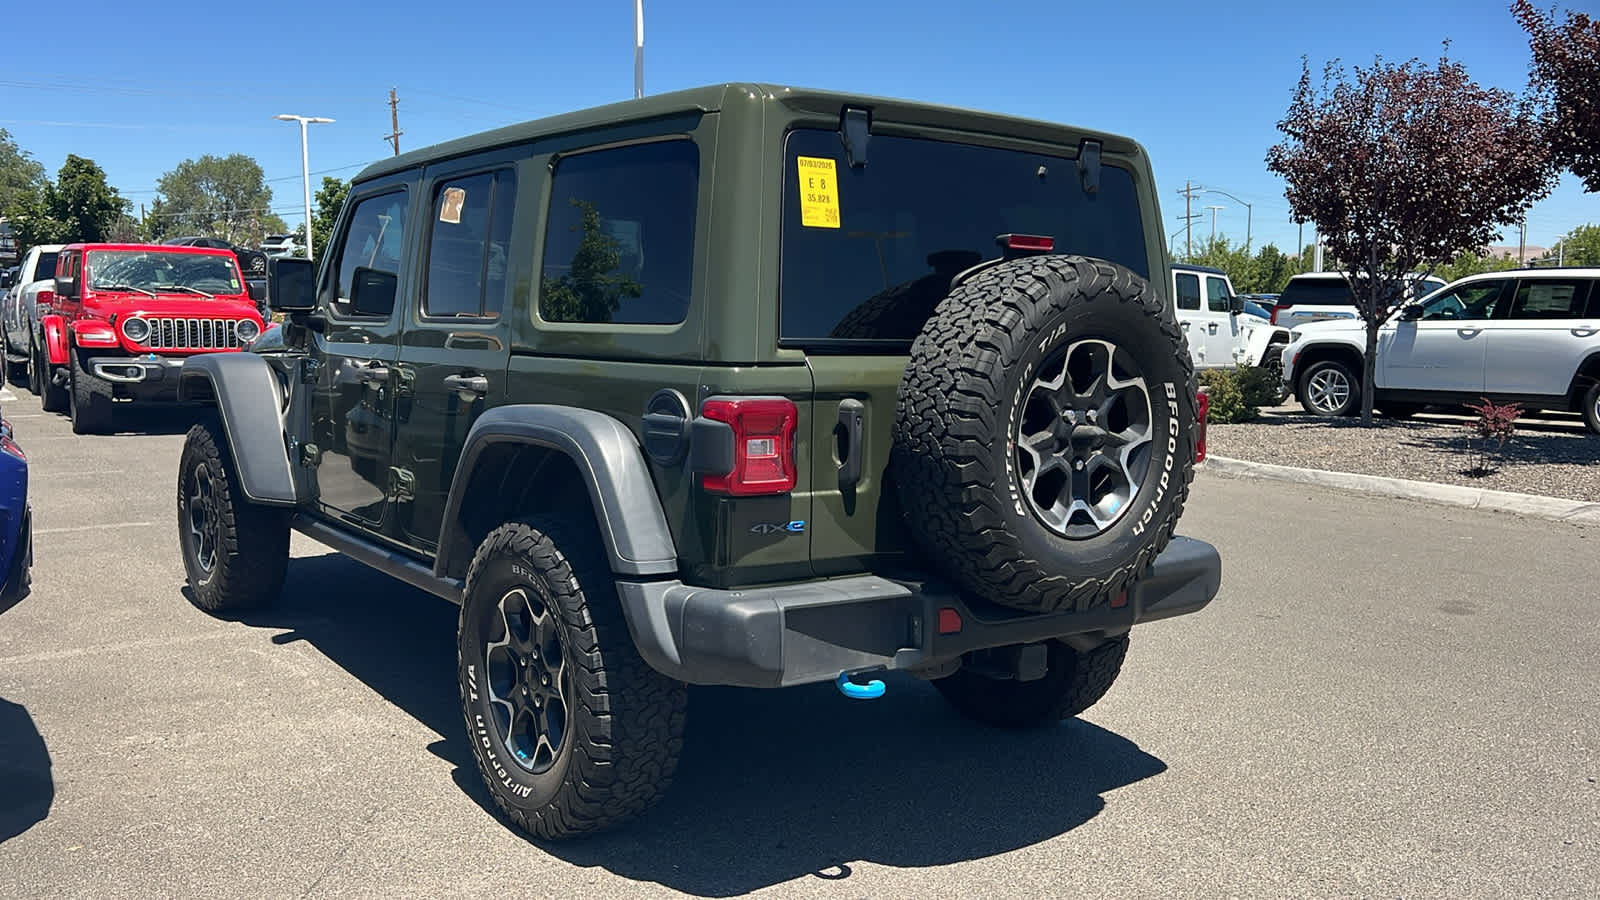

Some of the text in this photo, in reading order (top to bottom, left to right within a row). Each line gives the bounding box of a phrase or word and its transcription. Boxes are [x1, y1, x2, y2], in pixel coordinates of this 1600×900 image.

[809, 177, 826, 190] E 8
[1005, 321, 1068, 517] All-Terrain T/A
[1132, 382, 1180, 537] BFGoodrich
[467, 664, 534, 799] All-Terrain T/A
